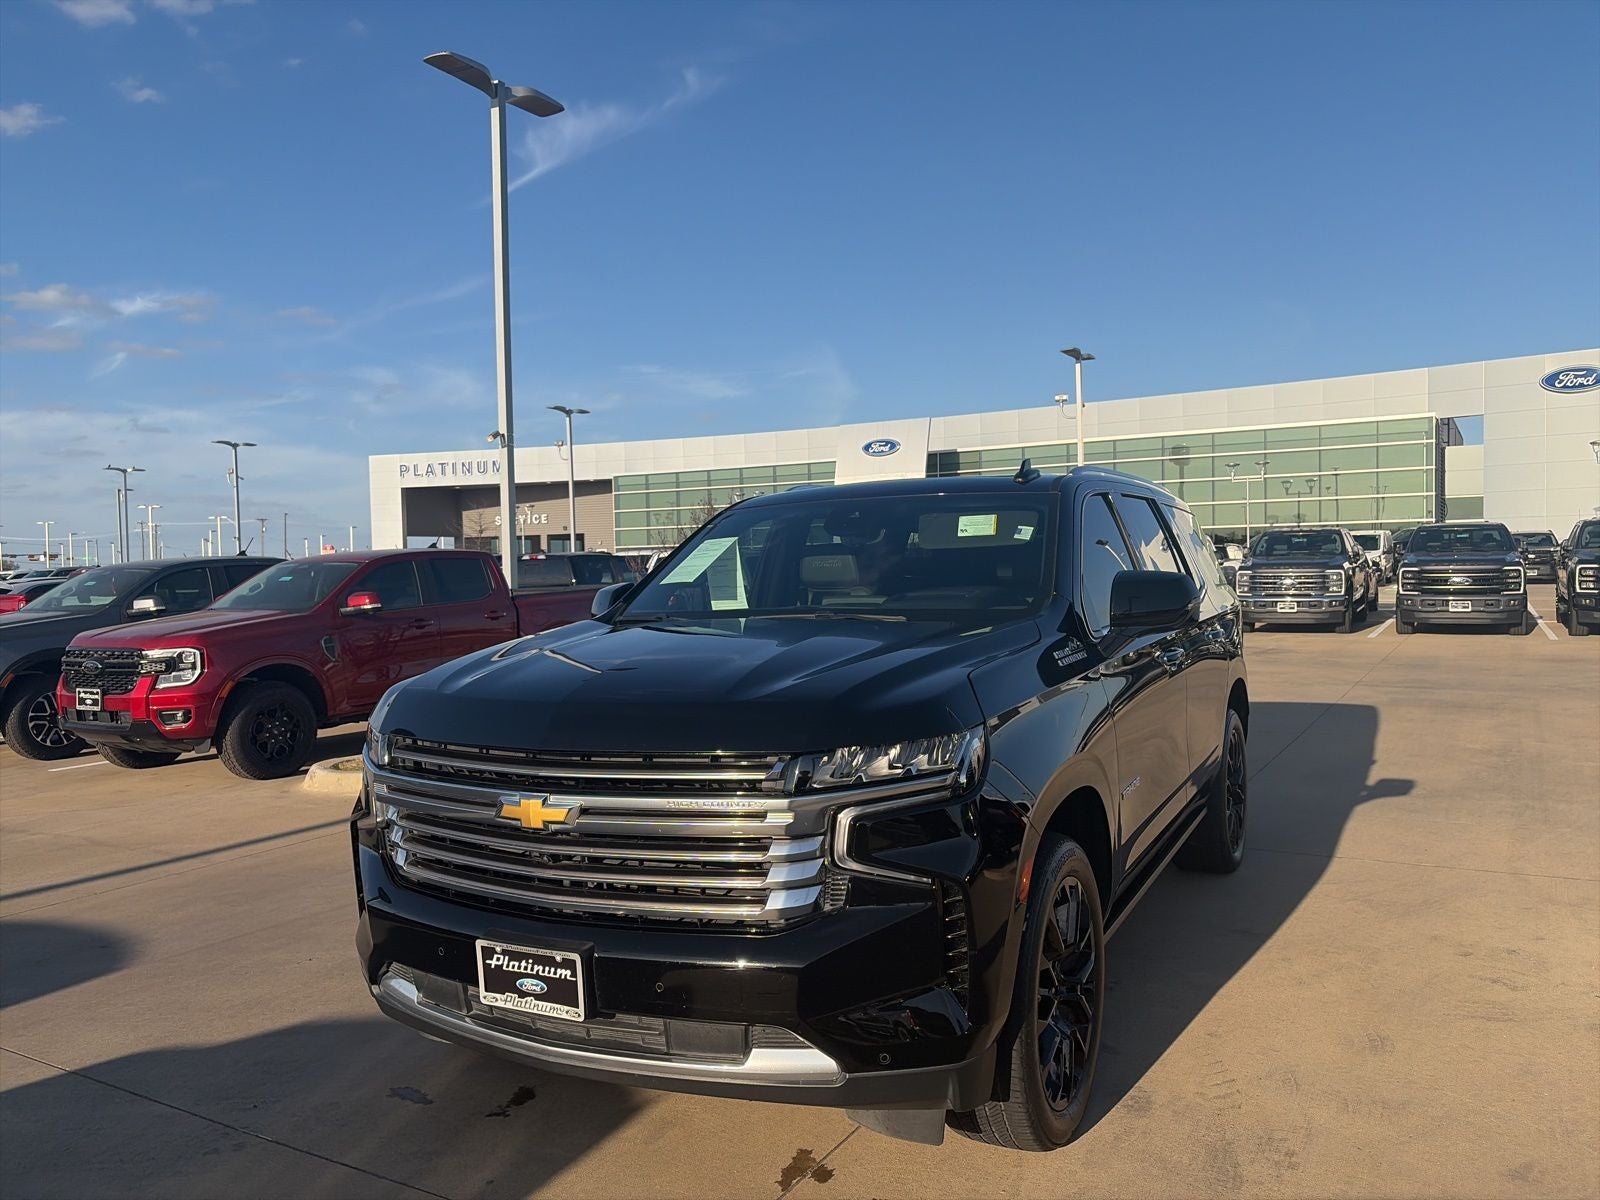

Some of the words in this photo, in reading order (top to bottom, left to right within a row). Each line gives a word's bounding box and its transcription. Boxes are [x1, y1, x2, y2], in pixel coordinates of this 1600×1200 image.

[1554, 370, 1598, 388] Ford
[868, 442, 891, 453] Ford
[495, 513, 549, 526] SVICE
[485, 953, 577, 981] Platinum
